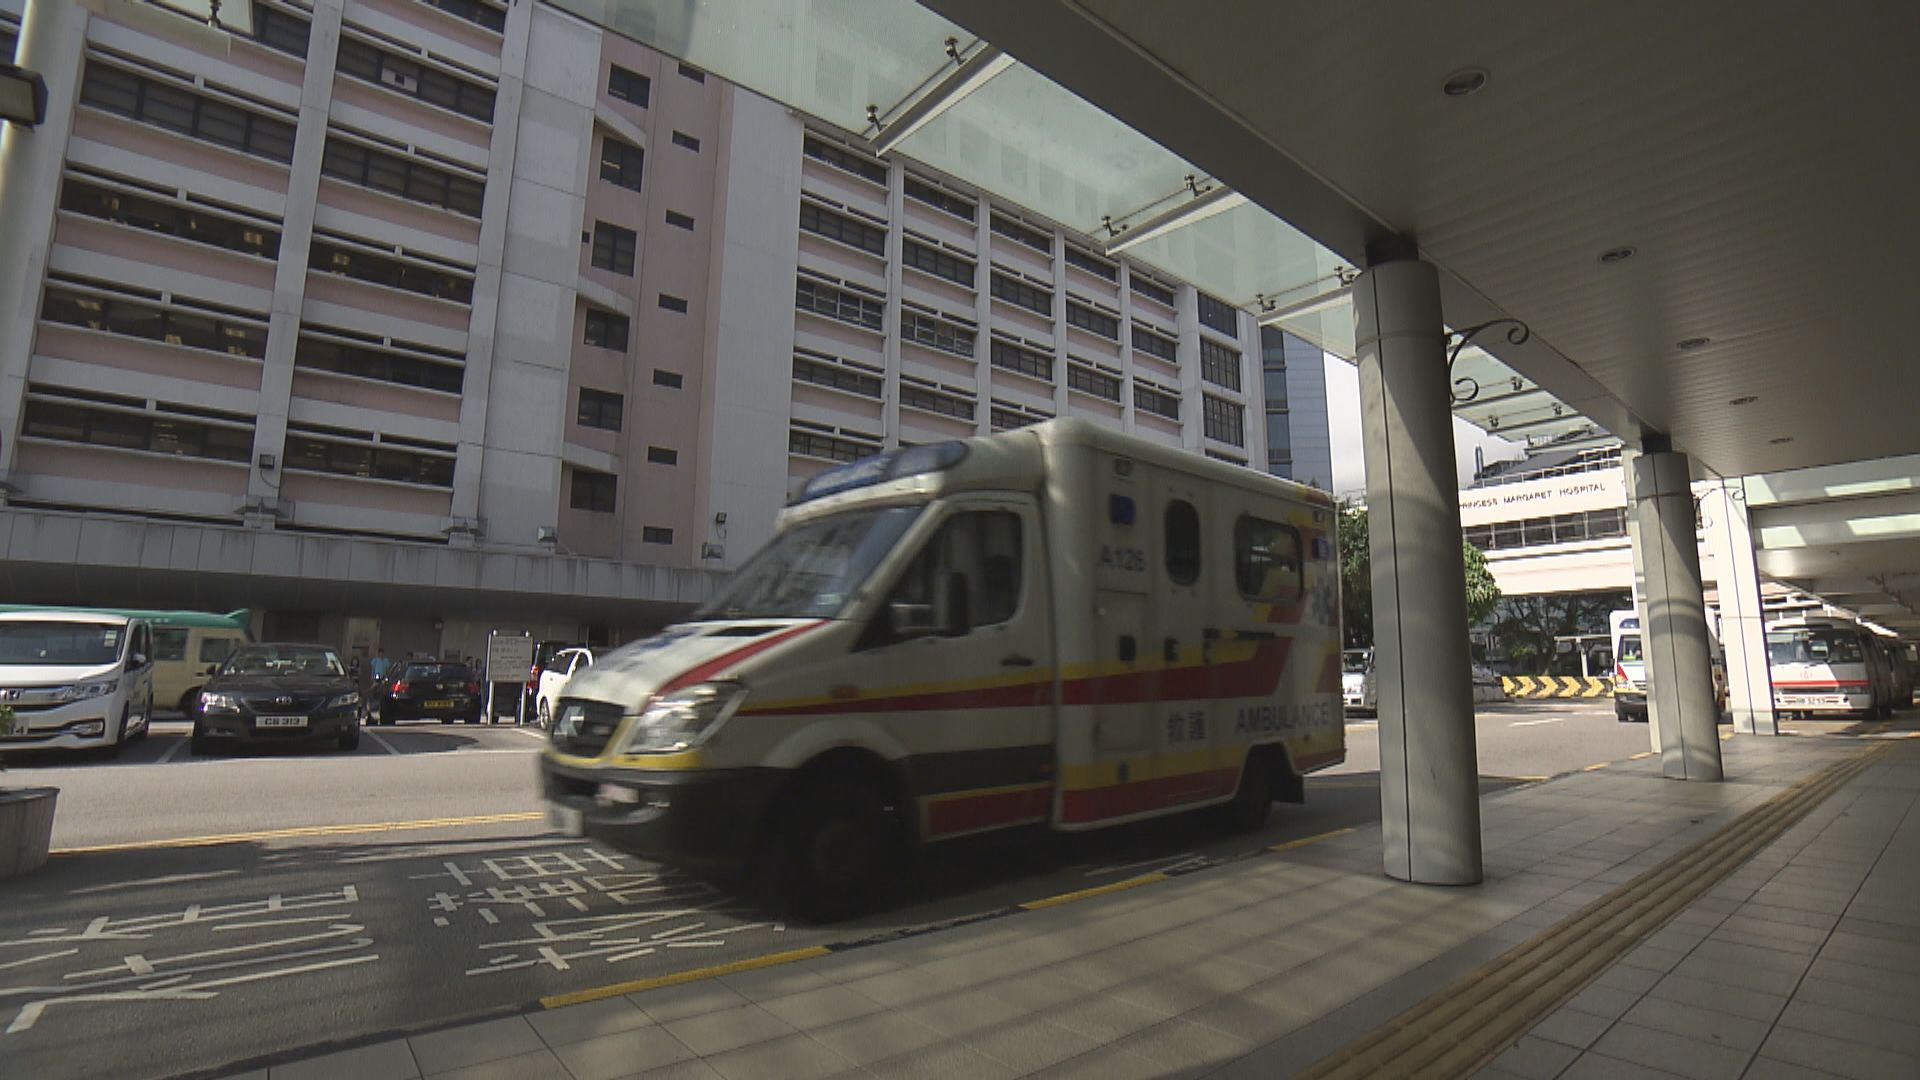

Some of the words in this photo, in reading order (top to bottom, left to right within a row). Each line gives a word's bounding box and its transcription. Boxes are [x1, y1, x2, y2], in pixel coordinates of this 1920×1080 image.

[1503, 490, 1552, 504] MARGARET
[1559, 483, 1605, 496] HOSPITAL
[1236, 703, 1329, 734] AMBULANCE
